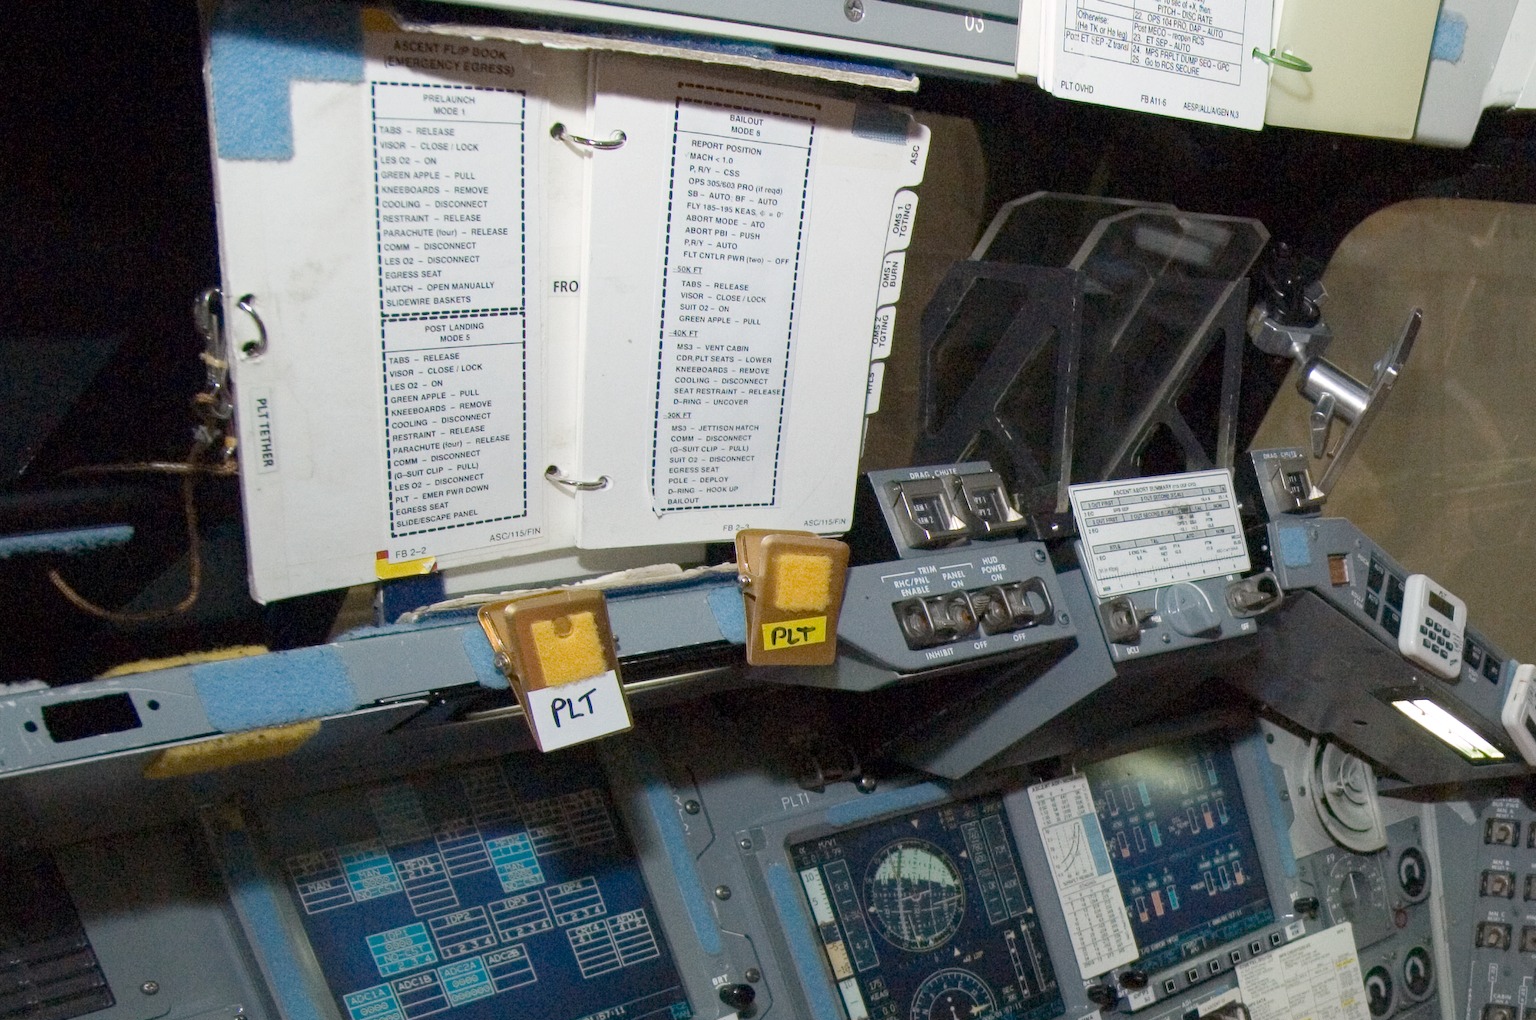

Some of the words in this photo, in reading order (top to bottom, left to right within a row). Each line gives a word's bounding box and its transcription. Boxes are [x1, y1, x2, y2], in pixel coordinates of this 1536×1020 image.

[394, 41, 438, 53] ASCENT
[446, 43, 468, 56] FLIP
[472, 46, 507, 60] BOOK
[384, 55, 460, 70] (EMERGENCY
[463, 60, 515, 77] EGRESS)
[1175, 64, 1200, 75] SECURE
[1061, 80, 1073, 90] PLT
[1075, 82, 1094, 94] OVHD
[423, 94, 475, 104] PRELAUNCH
[1141, 95, 1149, 103] FB
[433, 107, 460, 115] MODE
[730, 114, 764, 126] BAILOUT
[379, 126, 401, 135] TABS
[416, 127, 455, 136] RELEASE
[731, 126, 754, 135] MODE
[380, 142, 406, 150] VISOR
[692, 140, 723, 150] REPORT
[726, 145, 762, 155] POSITION
[910, 145, 920, 165] ASC
[381, 171, 410, 179] GREEN
[413, 171, 440, 179] APPLE
[382, 186, 440, 194] KNEEBOARDS
[454, 186, 488, 194] REMOVE
[421, 270, 442, 278] SEAT
[890, 260, 898, 287] BURN
[385, 285, 413, 293] HATCH
[427, 283, 449, 291] OPEN
[452, 281, 494, 290] MANUALLY
[554, 280, 578, 292] FRO
[386, 298, 430, 307] SLIDEWIRE
[433, 296, 471, 304] BASKETS
[450, 323, 484, 331] LANDING
[257, 399, 268, 419] PLT
[259, 422, 274, 467] TETHER
[910, 472, 930, 480] DRAG
[935, 468, 957, 477] CHUTE
[396, 514, 451, 528] SLIDE/ESCAPE
[453, 510, 478, 518] PANEL
[804, 518, 846, 526] ASC/115/FIN
[490, 528, 541, 542] ASC/115/FIN
[395, 550, 408, 558] FB
[982, 557, 998, 565] HUD
[918, 566, 936, 575] TRIM
[981, 564, 1007, 574] POWER
[943, 571, 966, 581] PANEL
[991, 573, 1003, 582] ON
[894, 577, 930, 589] RHC/PNL
[951, 580, 964, 588] ON
[901, 585, 930, 597] ENABLE
[771, 625, 815, 646] PLT
[1013, 633, 1026, 642] OFF
[974, 641, 988, 650] OFF
[925, 648, 954, 660] INHIBIT
[551, 688, 596, 728] PLT
[781, 793, 809, 808] PLT1
[444, 962, 476, 976] ADC2A
[399, 976, 432, 990] ADC1B
[712, 974, 728, 985] BRT
[351, 989, 385, 1004] ADC1A
